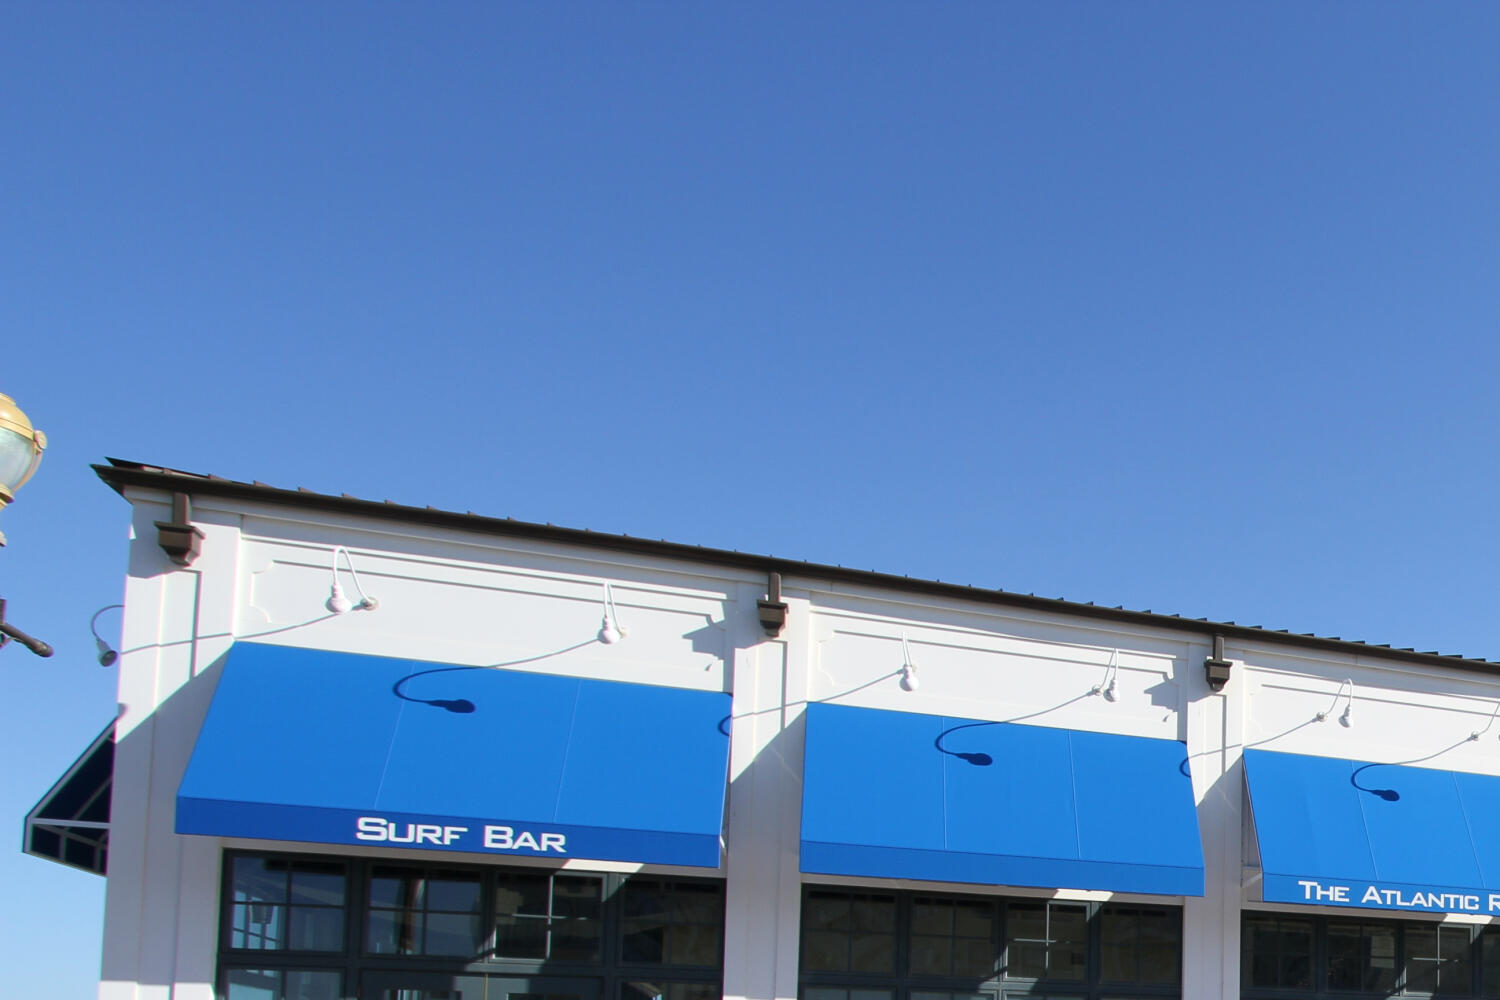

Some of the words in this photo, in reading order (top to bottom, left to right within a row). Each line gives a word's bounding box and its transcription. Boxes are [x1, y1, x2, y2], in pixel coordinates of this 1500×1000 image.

[356, 817, 469, 845] SURF
[484, 825, 567, 853] BAR
[1298, 880, 1350, 902] THE
[1361, 886, 1480, 911] ATLANTIC
